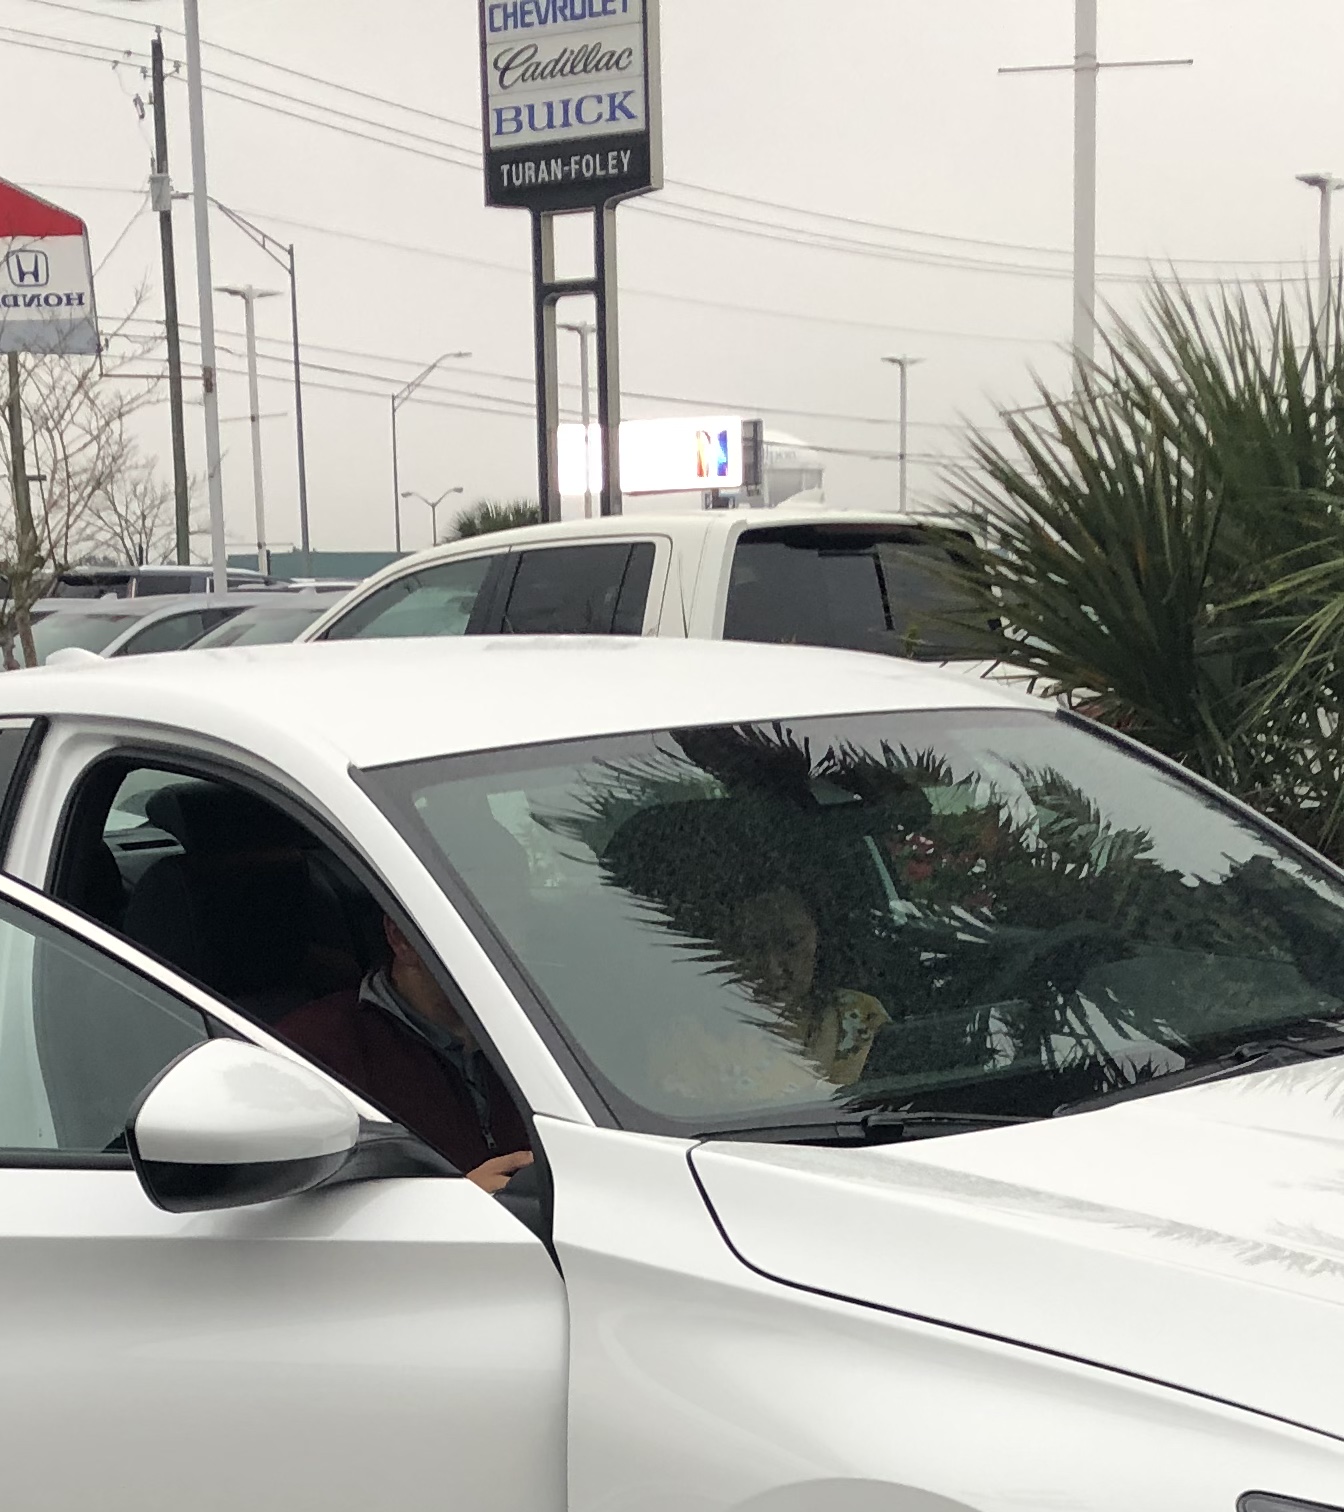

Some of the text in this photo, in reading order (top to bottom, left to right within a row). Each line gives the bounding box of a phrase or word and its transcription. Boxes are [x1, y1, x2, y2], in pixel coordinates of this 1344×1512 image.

[492, 42, 634, 90] Cadillac
[492, 89, 638, 136] BUICK
[500, 149, 632, 187] TURAN-FOLEY
